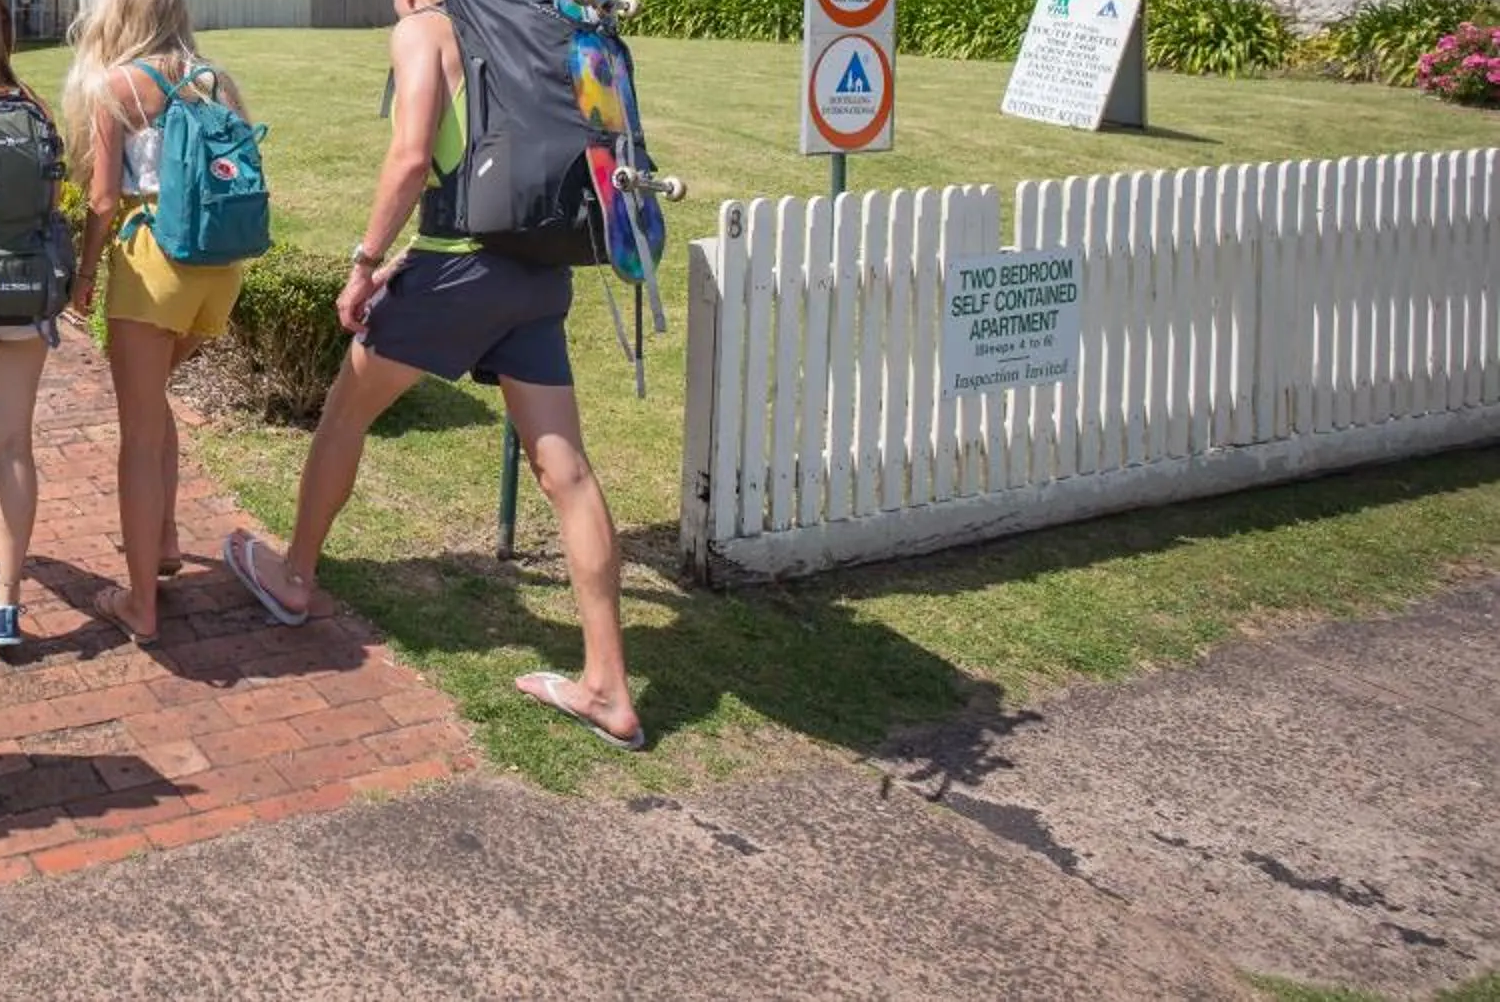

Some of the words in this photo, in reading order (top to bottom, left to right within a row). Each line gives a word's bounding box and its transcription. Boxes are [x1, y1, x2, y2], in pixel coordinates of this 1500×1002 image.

[959, 266, 997, 290] TWO
[1000, 258, 1074, 286] BEDROOM
[951, 292, 991, 317] SELF
[995, 282, 1077, 312] CONTAINED
[969, 309, 1060, 341] APARTMENT
[955, 369, 1019, 390] Inspection
[1025, 358, 1069, 379] Invited
